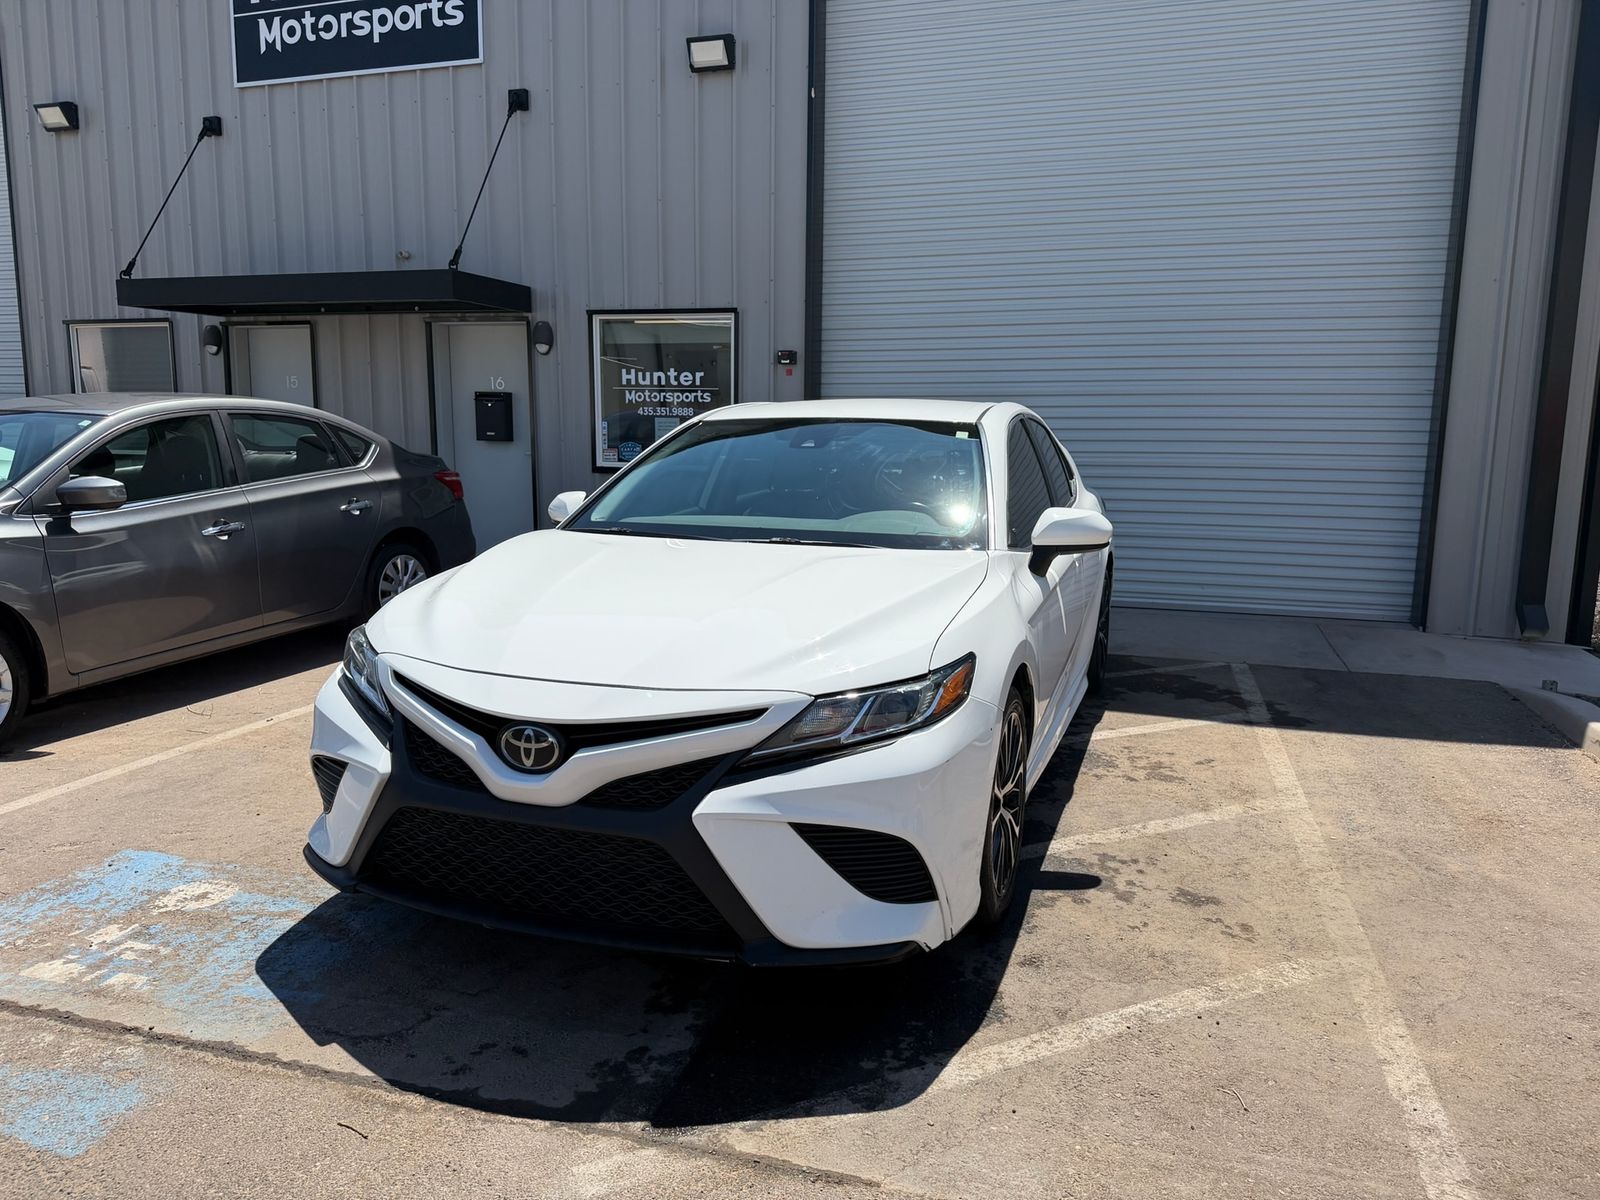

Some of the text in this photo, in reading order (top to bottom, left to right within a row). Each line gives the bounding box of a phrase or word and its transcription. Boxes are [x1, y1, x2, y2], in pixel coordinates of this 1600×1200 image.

[257, 0, 465, 55] Motorsports
[286, 375, 298, 389] 15
[490, 376, 505, 390] 16
[621, 368, 705, 386] Hunter
[625, 390, 712, 405] Motorsports
[637, 407, 694, 416] 435.351.9888
